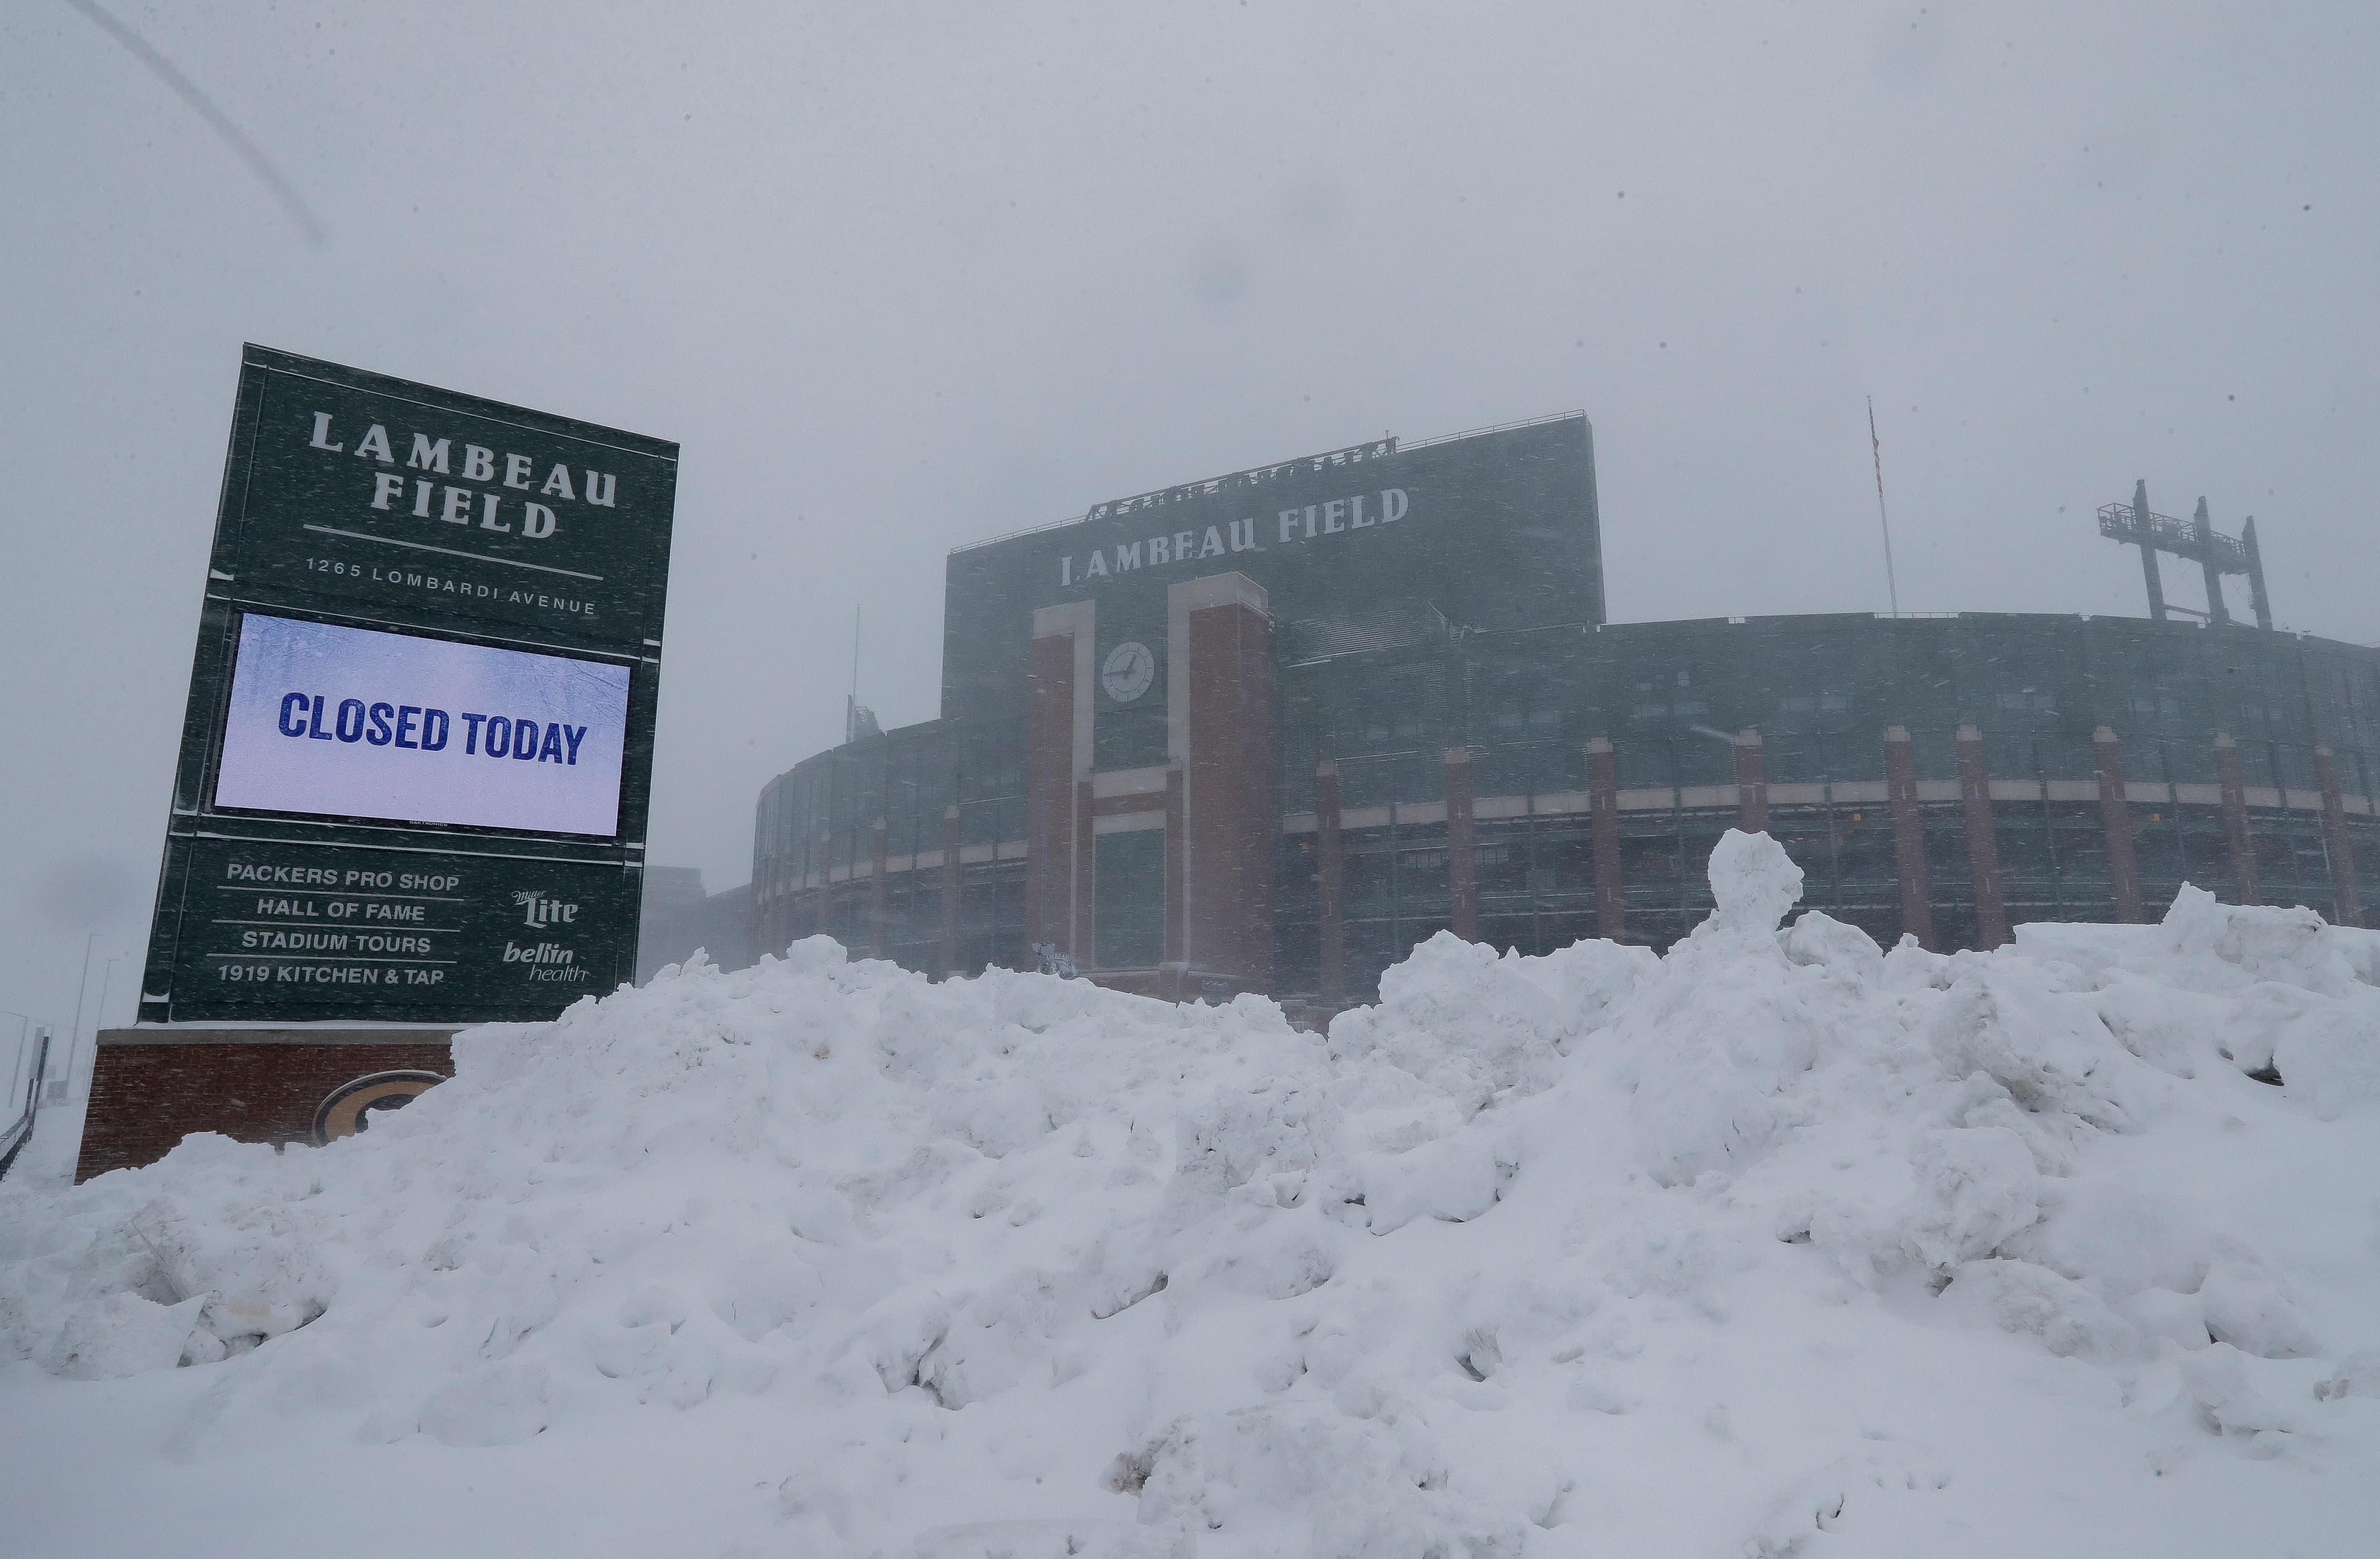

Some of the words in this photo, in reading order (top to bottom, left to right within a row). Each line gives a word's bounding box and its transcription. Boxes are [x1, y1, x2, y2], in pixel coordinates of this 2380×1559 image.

[310, 411, 617, 507] LAMBEAU
[371, 472, 556, 538] FIELD
[1060, 517, 1256, 587] LAMBEAU
[1278, 488, 1409, 543] FIELD
[306, 558, 361, 577] 1265
[372, 568, 498, 600] LOMBARDI
[509, 590, 596, 615] AVENUE
[278, 692, 449, 752] CLOSED
[462, 713, 588, 765] TODAY
[227, 864, 338, 884] PACKERS
[346, 869, 392, 889] PRO
[400, 874, 459, 892] SHOP
[257, 899, 318, 917] HALL
[328, 902, 358, 919] OF
[366, 904, 425, 921] FAME
[511, 890, 547, 905] Miller
[524, 898, 578, 928] Lite
[242, 932, 348, 951] STADIUM
[355, 936, 431, 954] TOURS
[503, 942, 573, 964] bellin
[218, 965, 268, 982] 1919
[276, 967, 377, 983] KITCHEN
[384, 969, 400, 985] &
[405, 970, 444, 985] TAP
[529, 964, 586, 982] health
